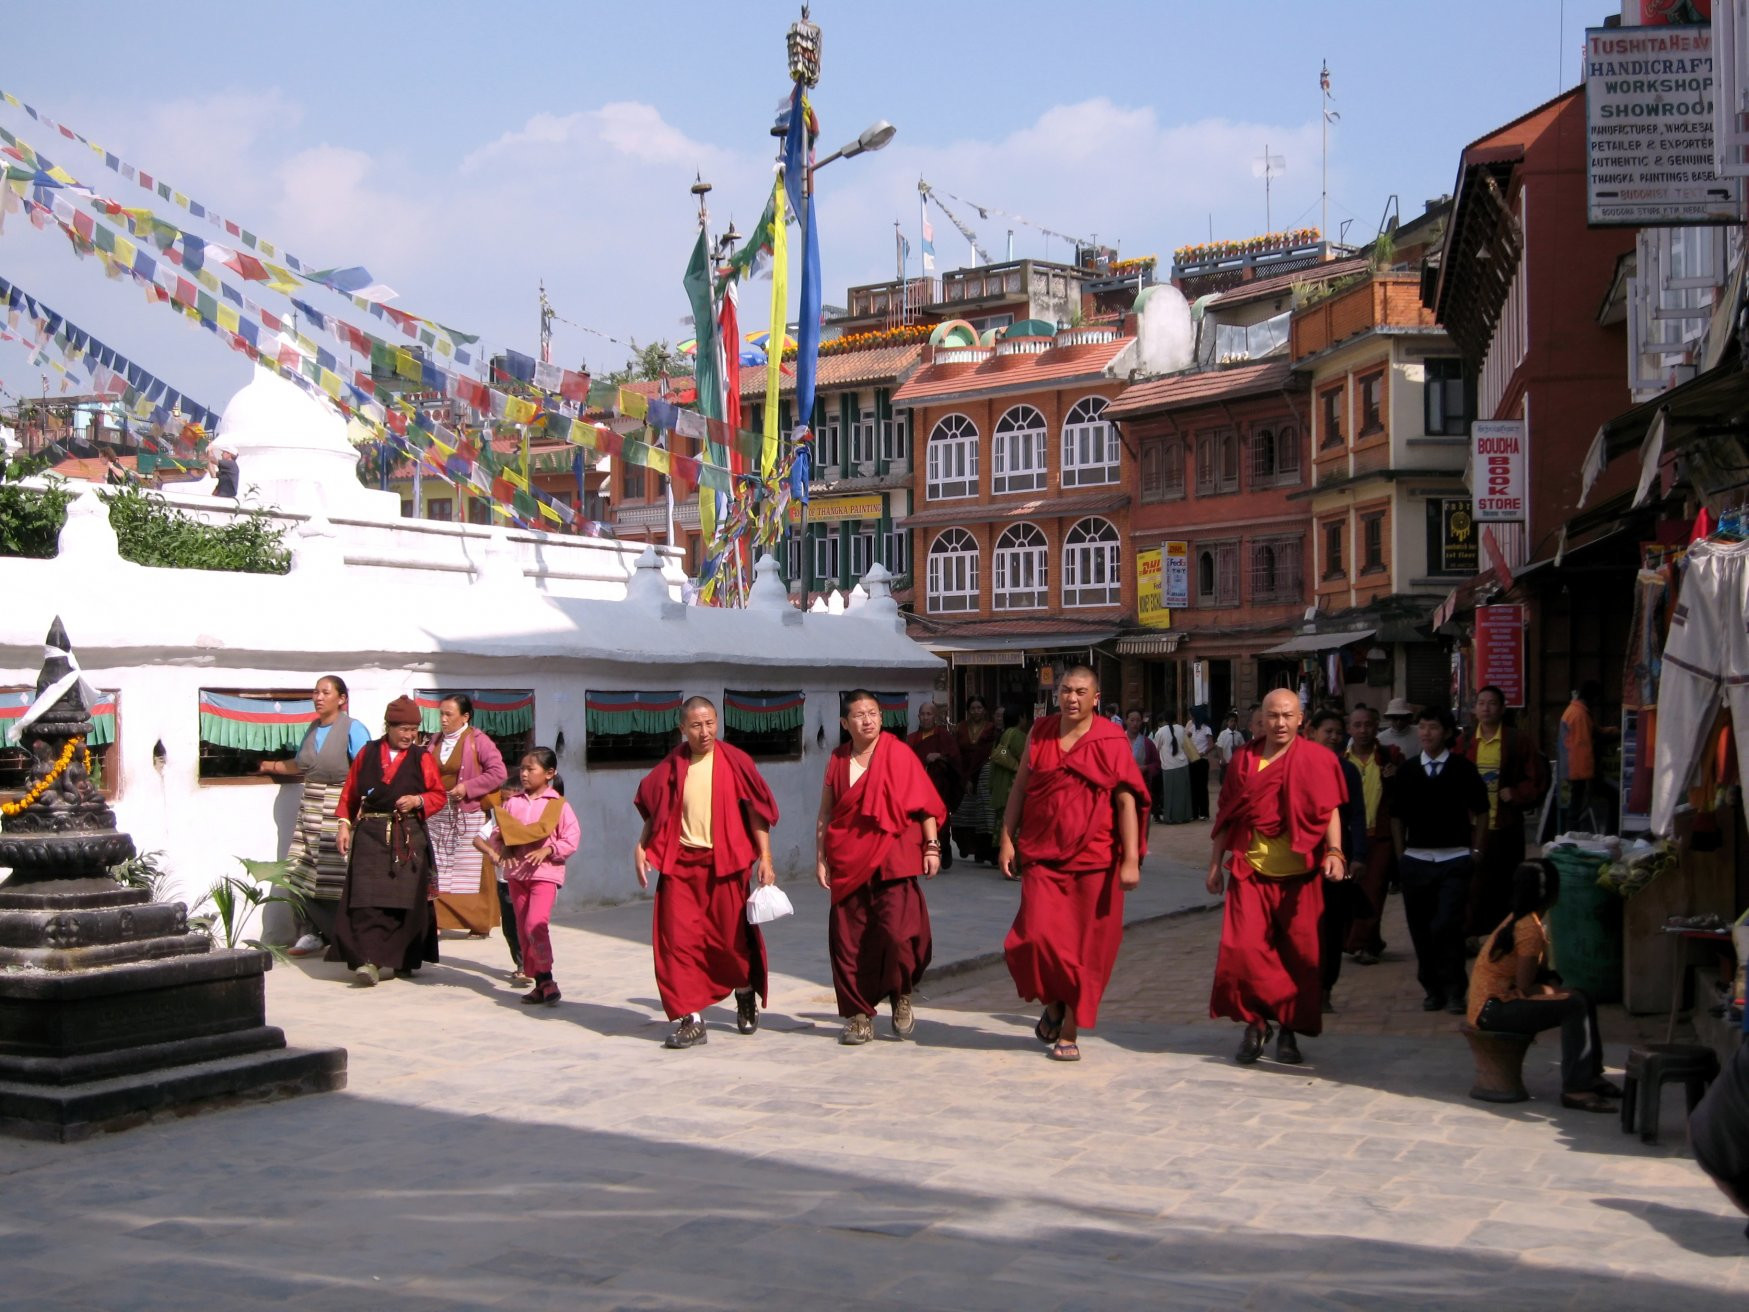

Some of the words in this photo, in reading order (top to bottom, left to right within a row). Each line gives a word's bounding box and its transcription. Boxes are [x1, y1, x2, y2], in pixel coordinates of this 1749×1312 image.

[1591, 36, 1667, 56] TUSHITA
[1605, 78, 1713, 94] WORKSHOP
[1591, 140, 1642, 152] RETAILER
[1647, 139, 1656, 150] &
[1591, 156, 1648, 167] AUTHENTIC
[1654, 155, 1664, 166] &
[1667, 154, 1714, 166] GENUINE
[1591, 173, 1634, 185] THANGKA
[1639, 171, 1689, 183] PAINTINGS
[1478, 437, 1520, 455] BOUDHA
[1488, 456, 1511, 496] BOOK
[817, 505, 848, 515] THANGKA
[850, 504, 882, 514] PAINTING
[1478, 498, 1521, 510] STORE
